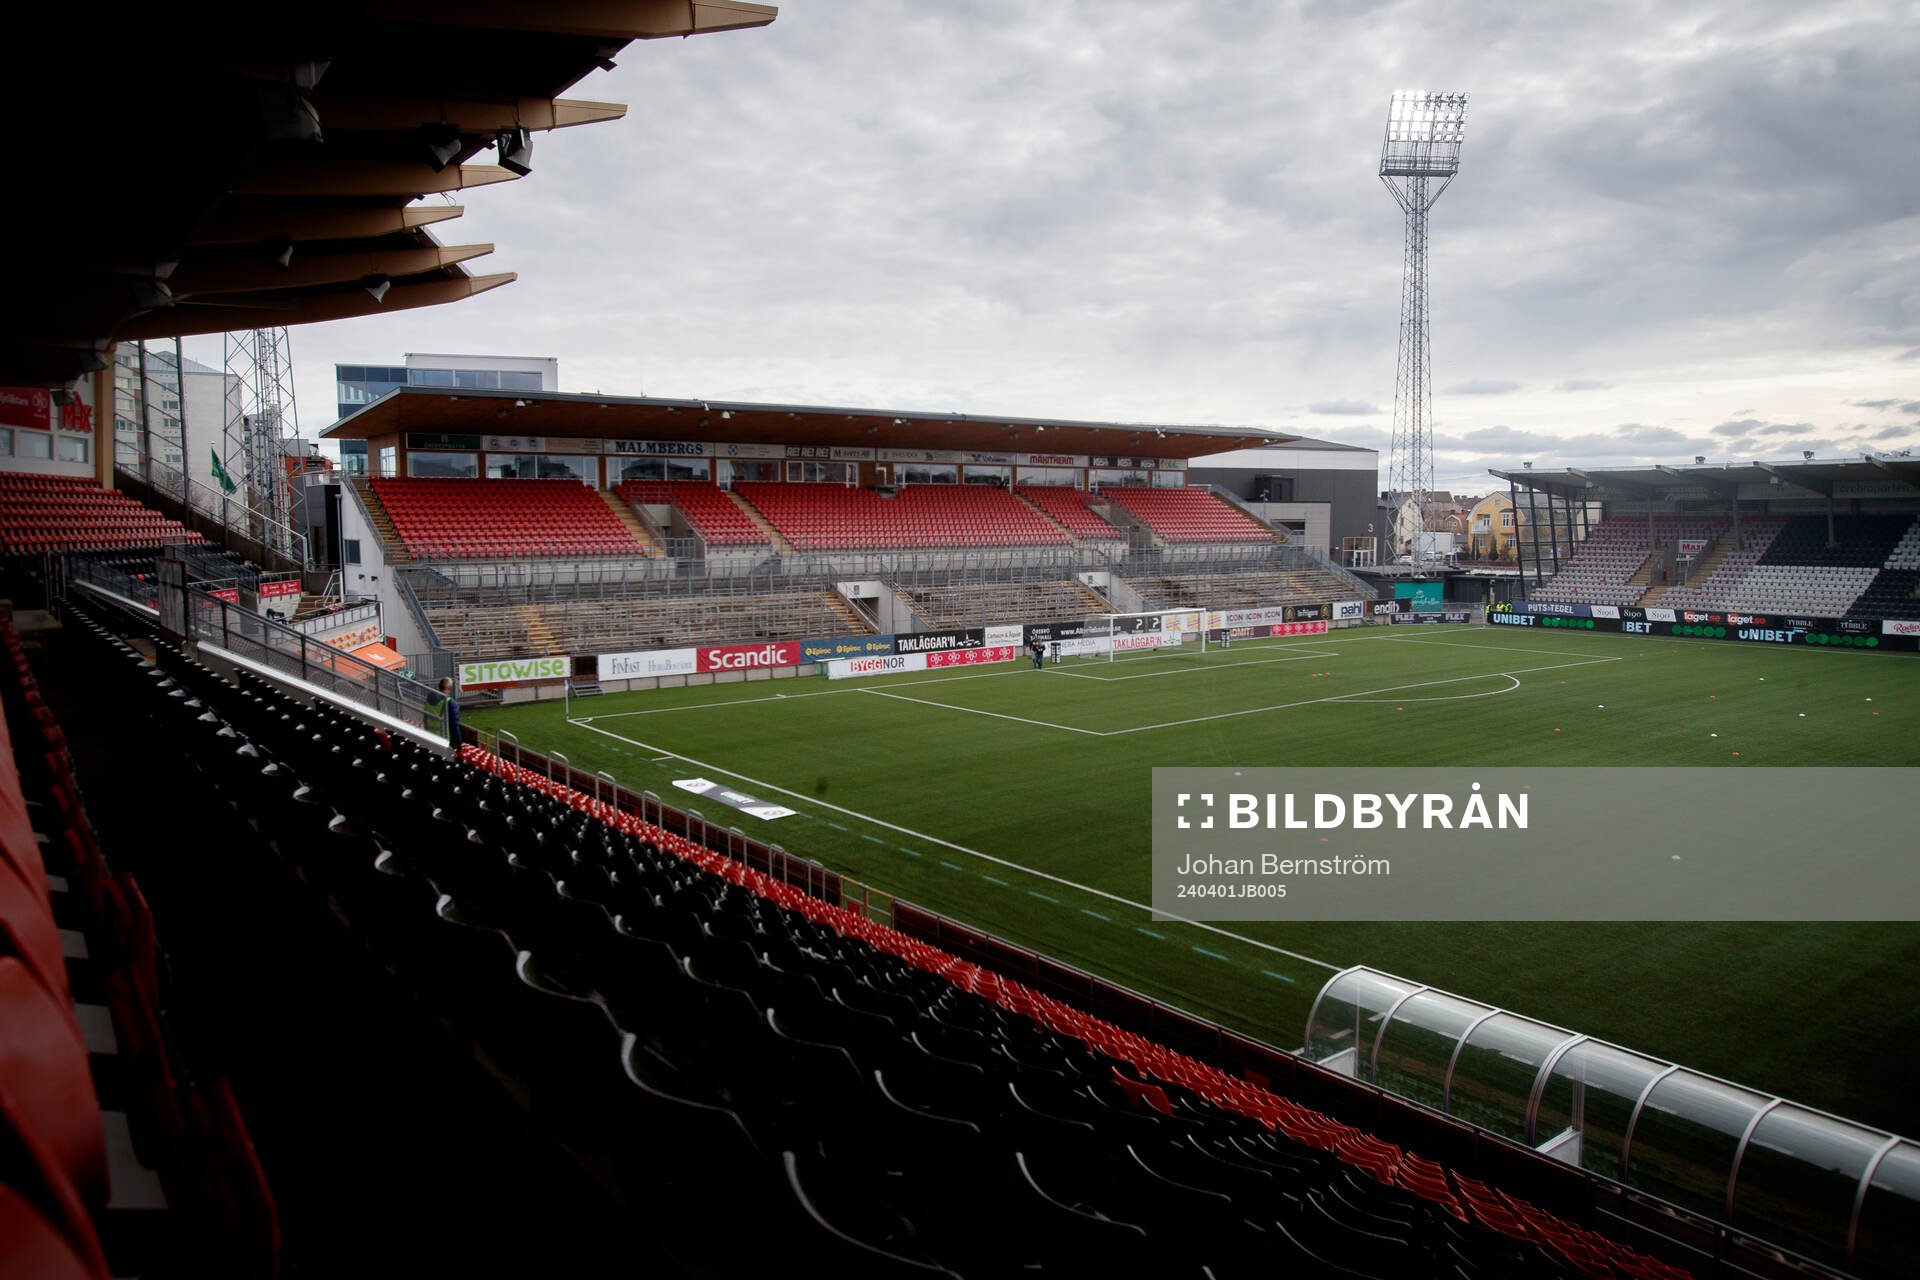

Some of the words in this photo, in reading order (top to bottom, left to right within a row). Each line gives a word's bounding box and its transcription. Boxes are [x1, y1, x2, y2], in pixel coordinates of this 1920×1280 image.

[616, 441, 703, 455] MALMBERGS
[1367, 523, 1374, 533] 3
[1341, 602, 1362, 618] pahl
[1623, 609, 1642, 619] 8190
[1493, 613, 1535, 625] UNIBET
[1739, 628, 1795, 642] UNIBET
[898, 635, 956, 651] TAKLÄGGAR'N
[708, 645, 787, 669] Scandic
[850, 657, 905, 673] BYGGNOR
